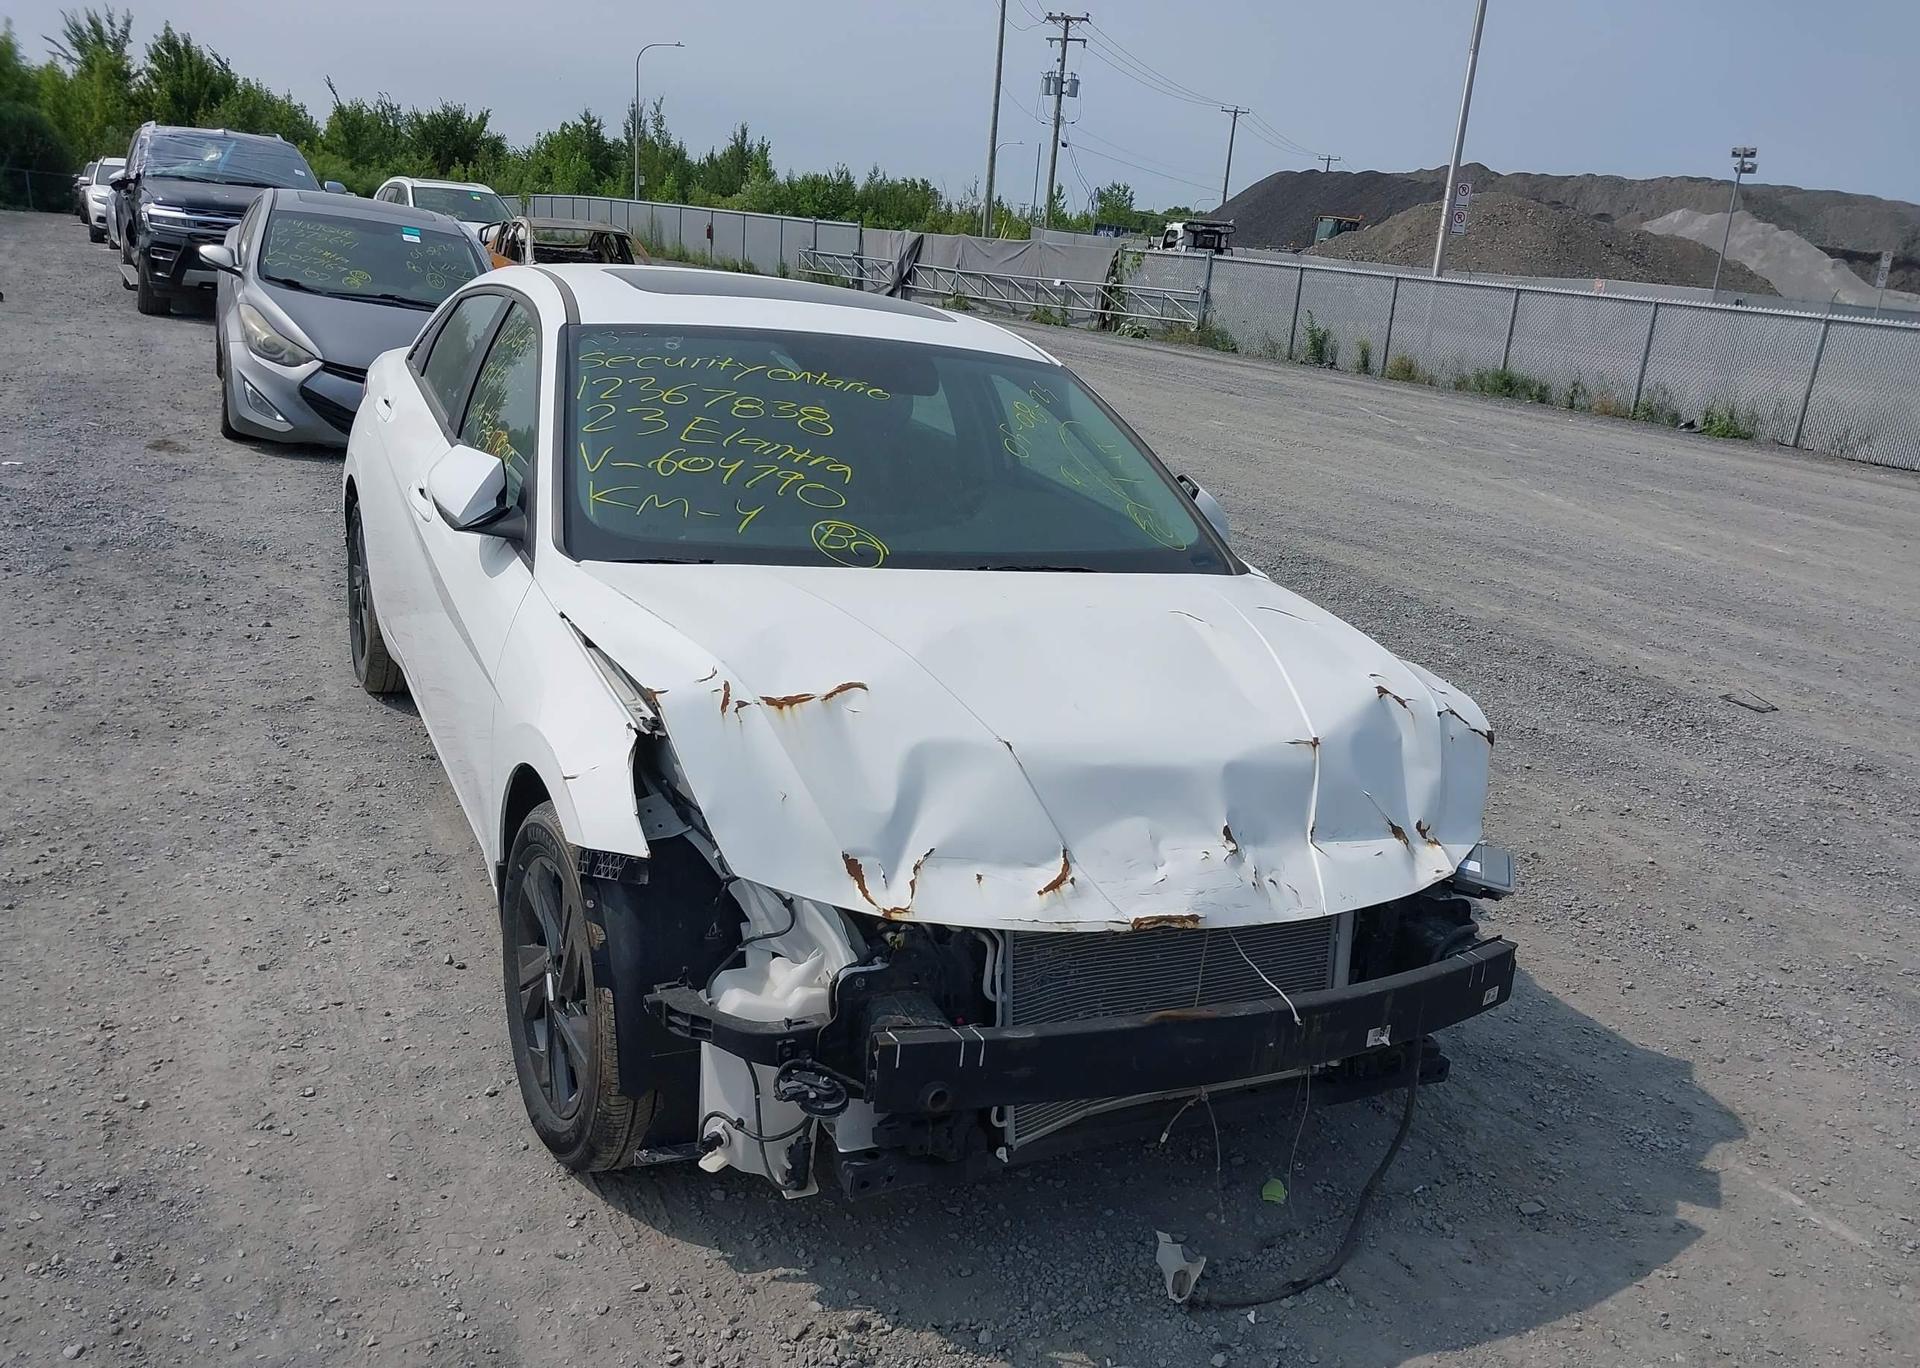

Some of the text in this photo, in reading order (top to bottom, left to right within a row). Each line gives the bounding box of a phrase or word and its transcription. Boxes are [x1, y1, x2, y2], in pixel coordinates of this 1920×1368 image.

[578, 352, 892, 400] Security Ontario
[582, 404, 854, 485] 23 Elantra
